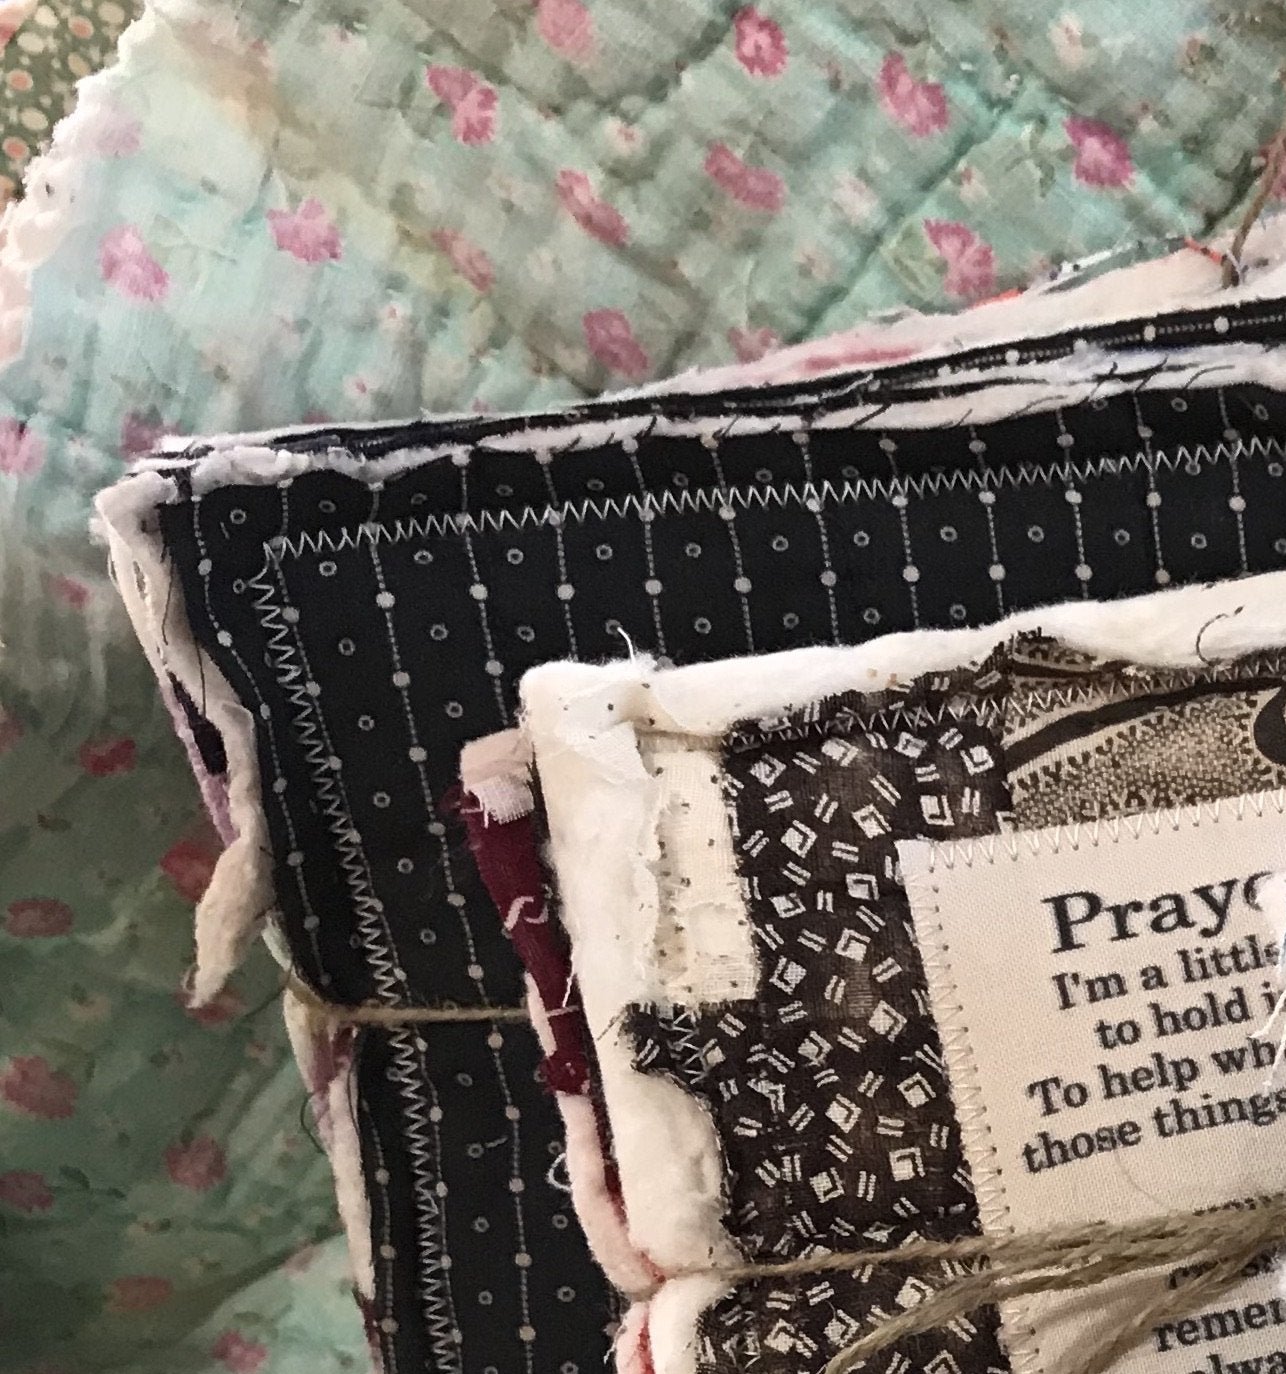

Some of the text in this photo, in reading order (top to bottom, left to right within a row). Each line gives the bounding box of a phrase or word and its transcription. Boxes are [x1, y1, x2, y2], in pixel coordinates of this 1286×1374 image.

[1052, 972, 1128, 1010] I'm
[1141, 964, 1168, 990] a
[1096, 1020, 1141, 1049] to
[1148, 987, 1250, 1037] hold
[1027, 1076, 1089, 1117] To
[1098, 1052, 1200, 1100] help
[1022, 1120, 1142, 1173] those
